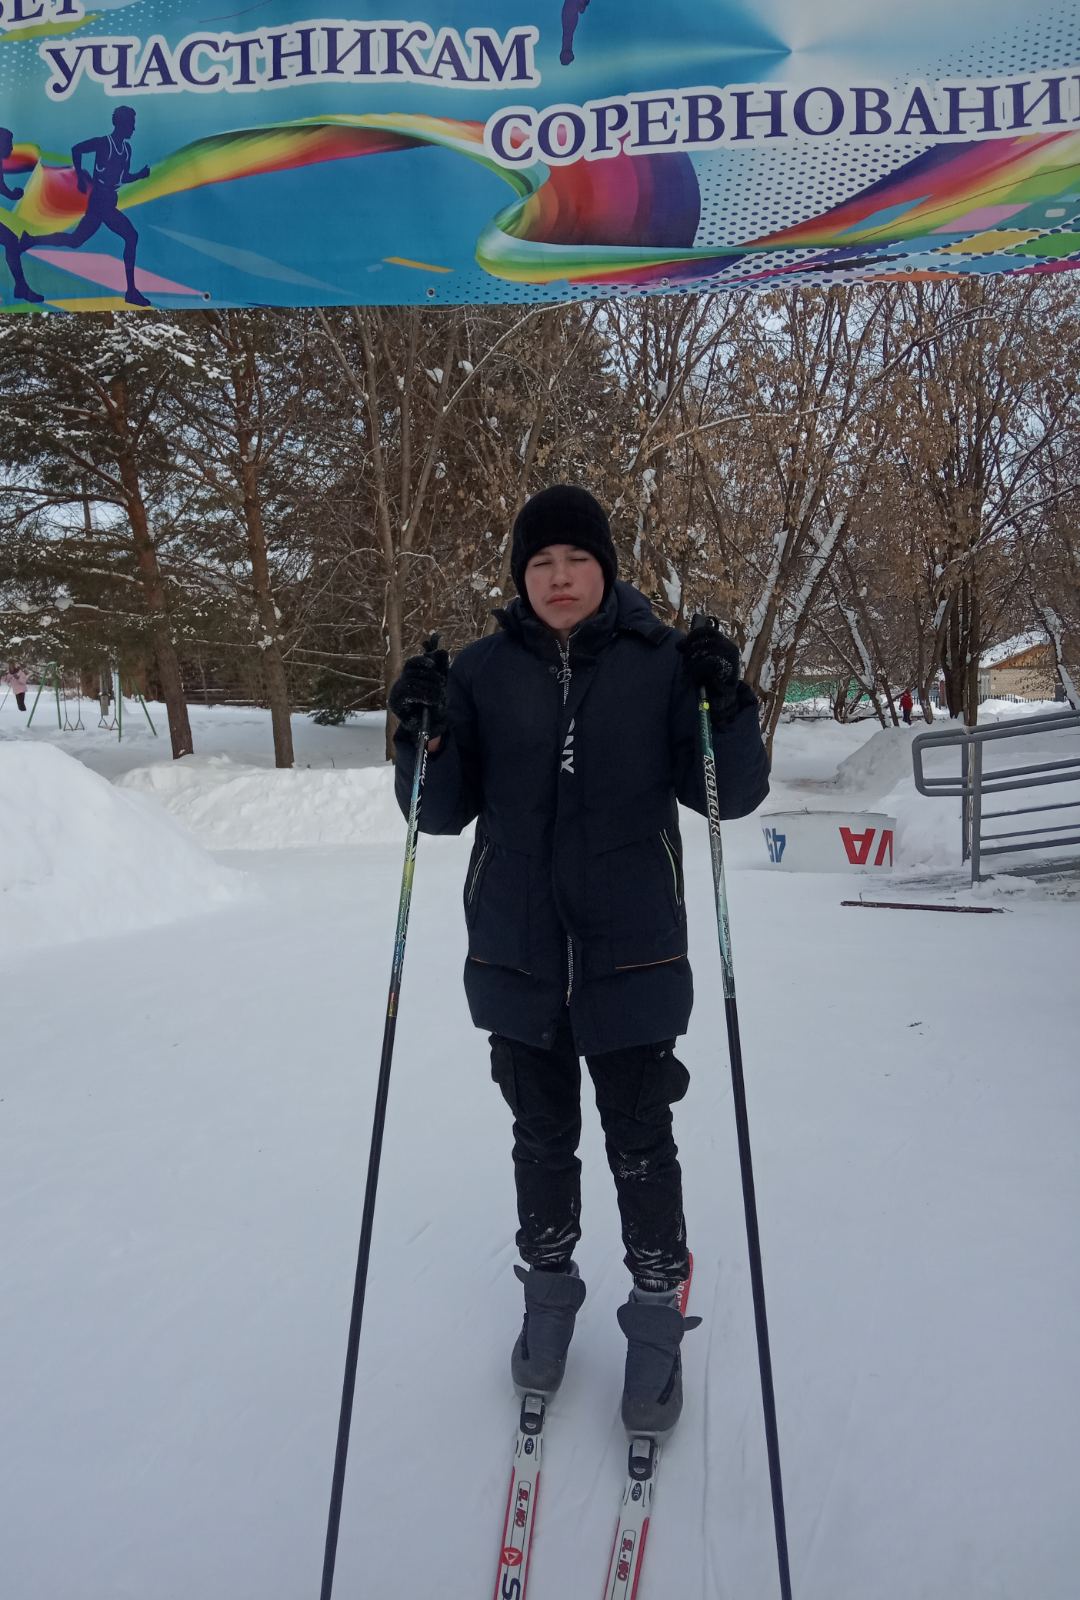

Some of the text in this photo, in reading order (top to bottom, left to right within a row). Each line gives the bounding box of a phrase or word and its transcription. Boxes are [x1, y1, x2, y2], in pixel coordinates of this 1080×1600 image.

[46, 27, 533, 94] УЧАСТНИКАМ
[703, 754, 721, 838] MOTOR
[762, 827, 787, 863] 45
